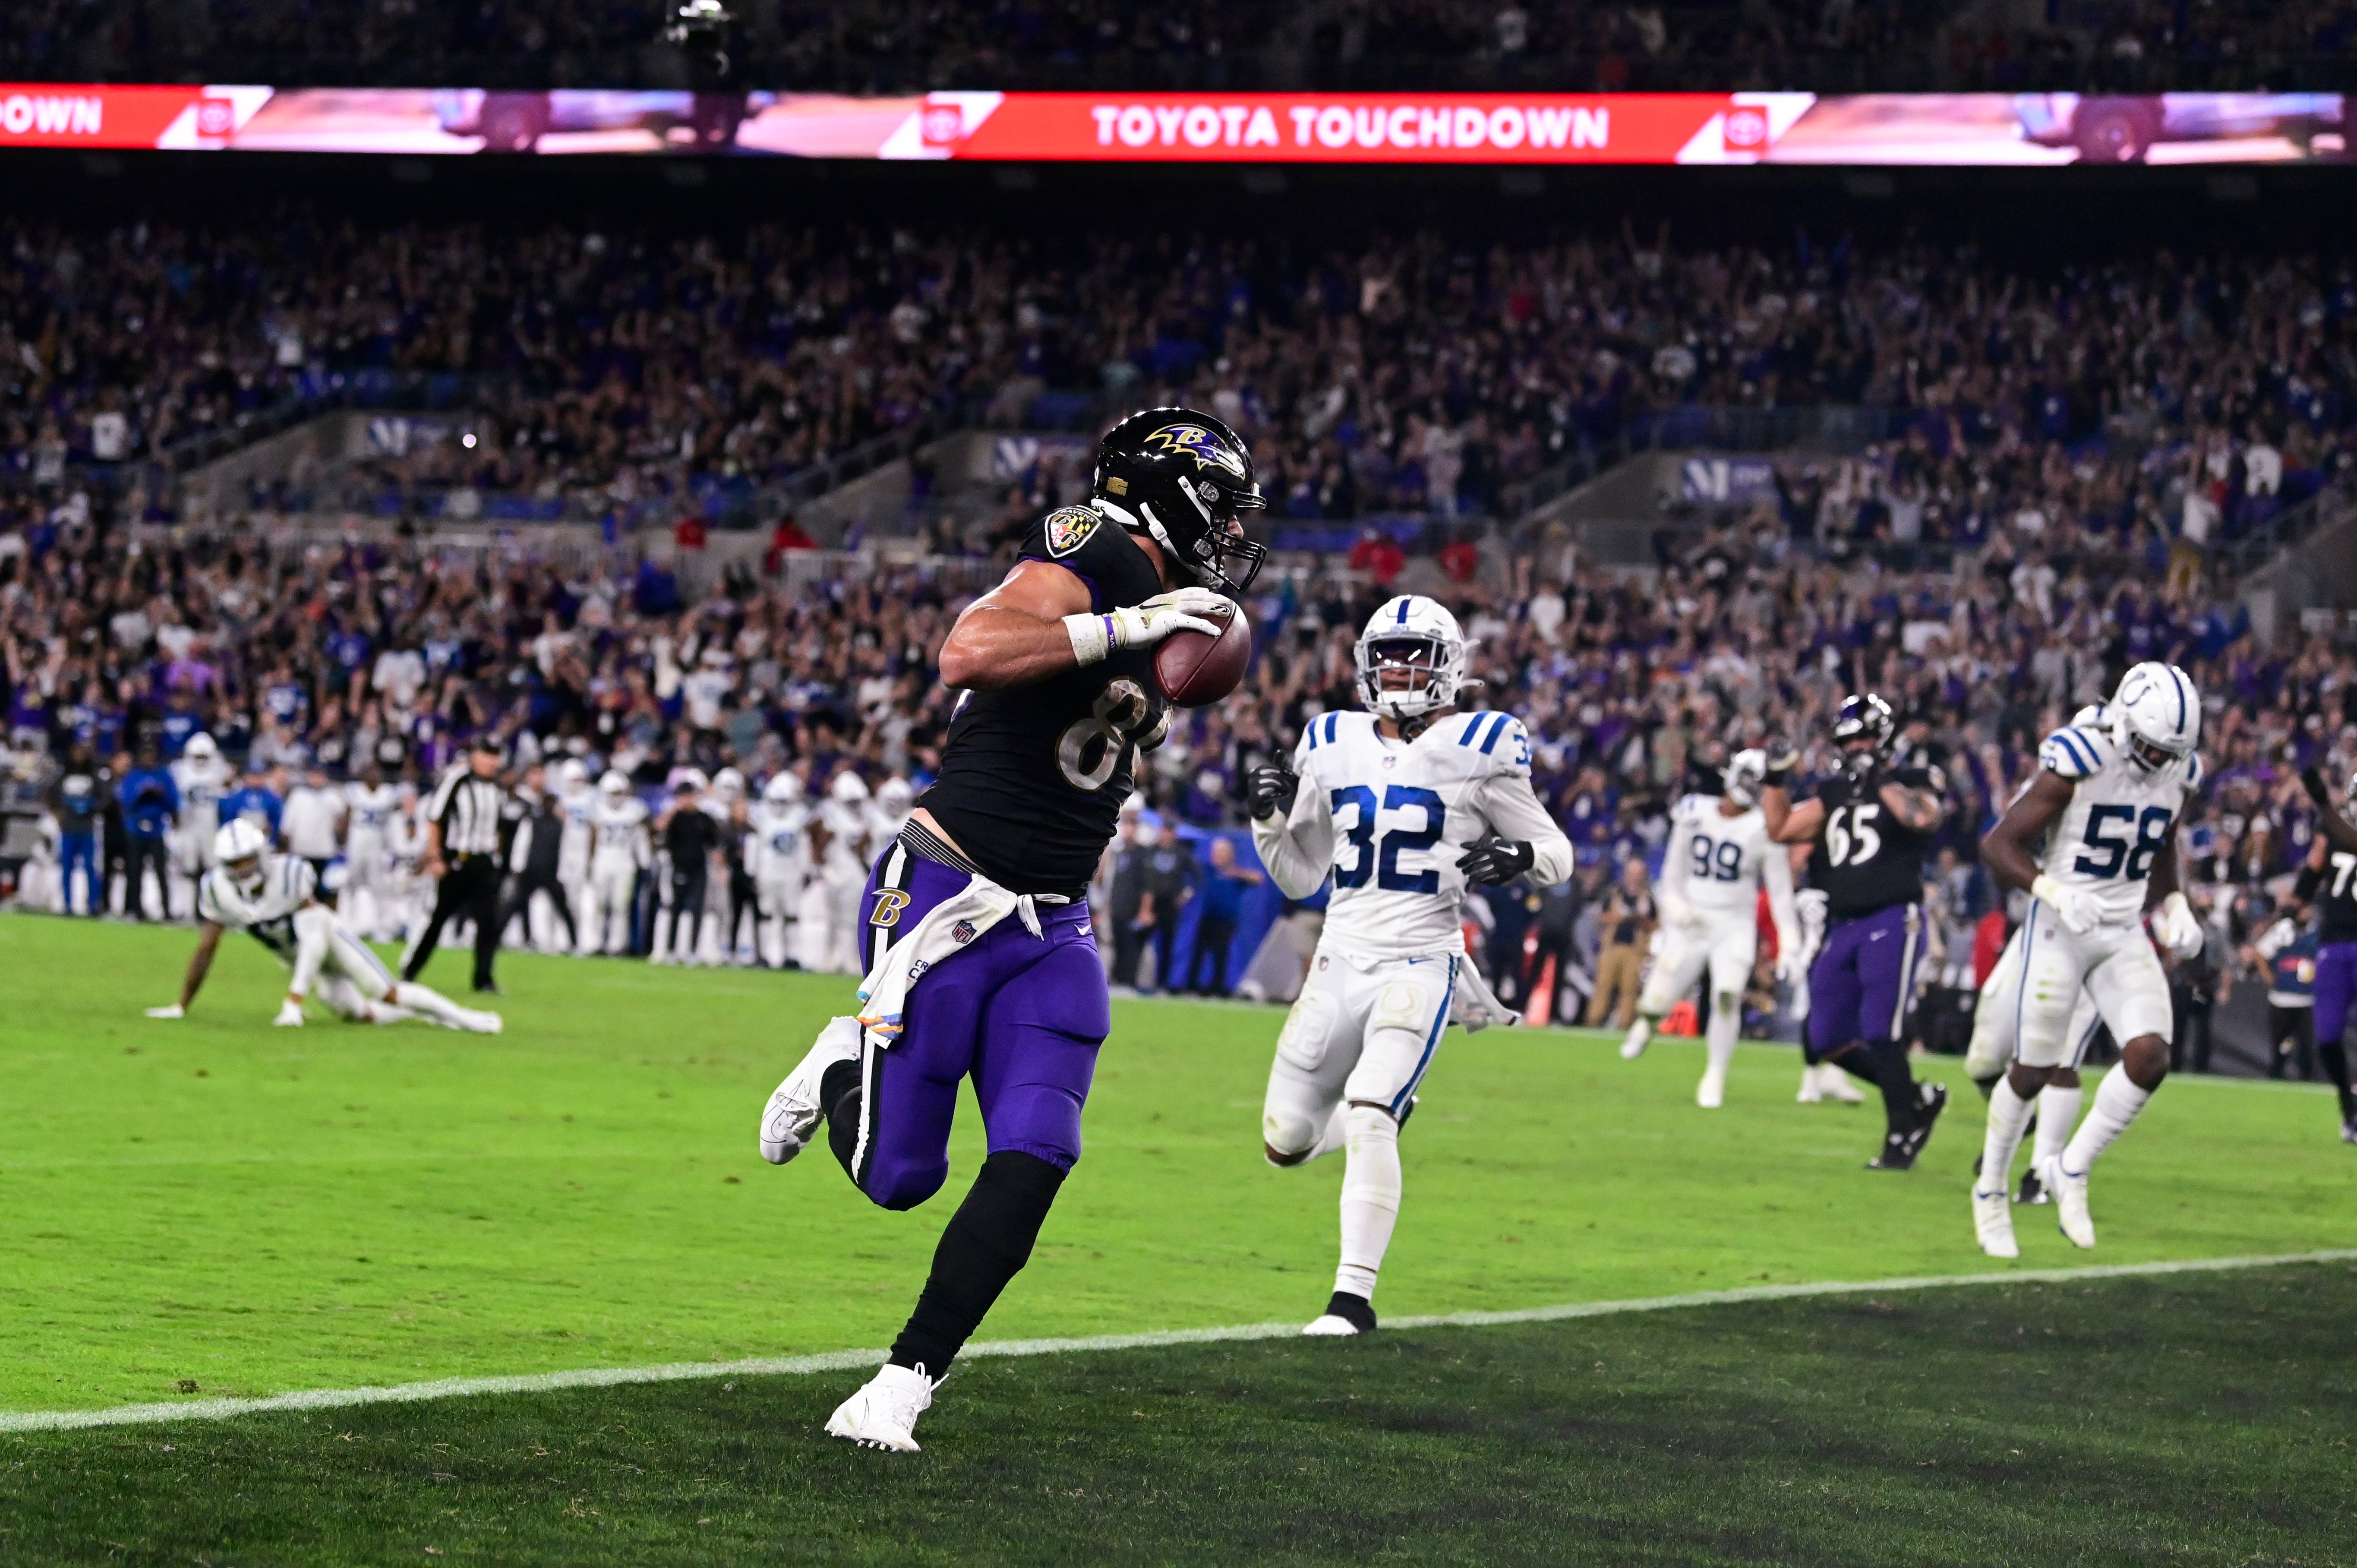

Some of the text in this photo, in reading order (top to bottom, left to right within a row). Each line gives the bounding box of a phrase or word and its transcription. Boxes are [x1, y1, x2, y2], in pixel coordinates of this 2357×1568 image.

[0, 94, 103, 134] OWN
[1090, 104, 1609, 149] TOYOTA TOUCHDOWN
[1169, 426, 1207, 445] B
[1055, 675, 1174, 792] 8
[1331, 785, 1445, 895] 32
[1691, 835, 1742, 881] 99
[1825, 803, 1881, 868] 65
[2074, 804, 2172, 881] 58
[2331, 851, 2357, 902] 7
[869, 888, 911, 927] B
[953, 927, 969, 943] NFL
